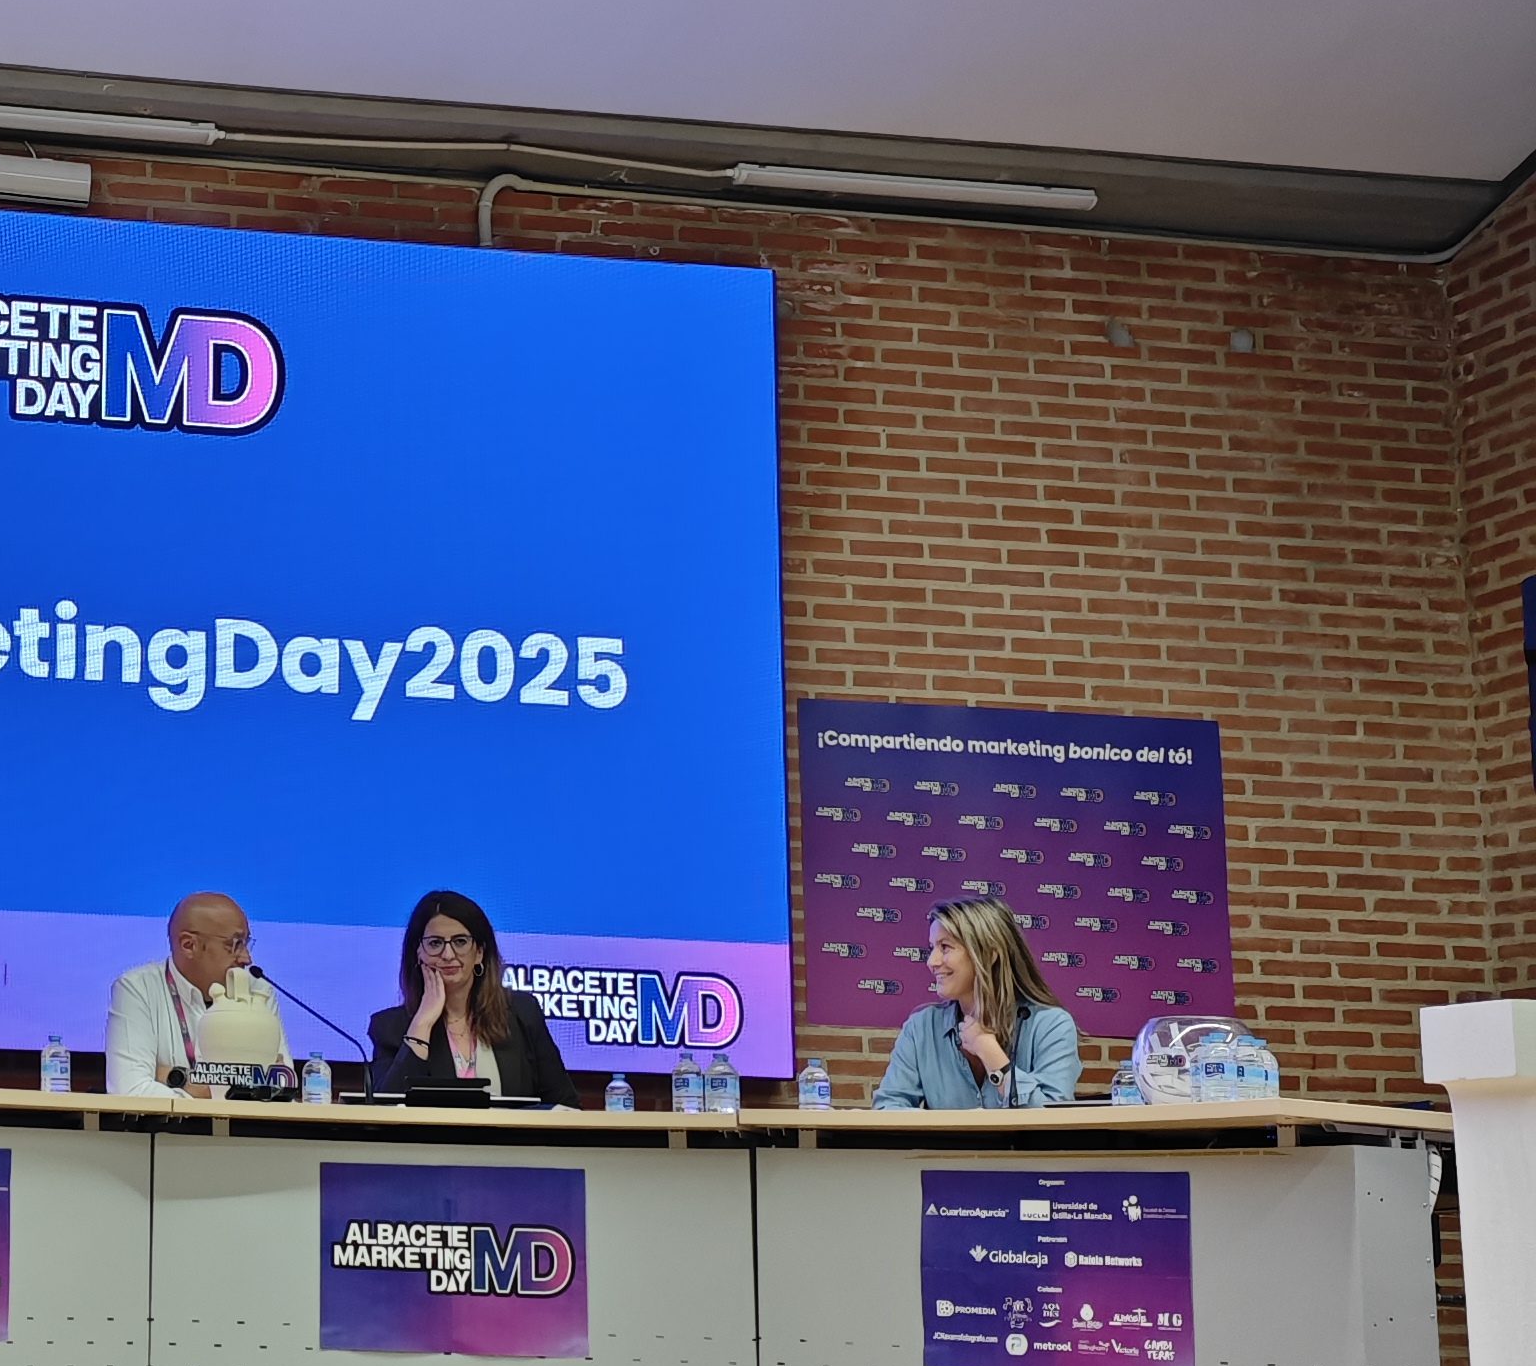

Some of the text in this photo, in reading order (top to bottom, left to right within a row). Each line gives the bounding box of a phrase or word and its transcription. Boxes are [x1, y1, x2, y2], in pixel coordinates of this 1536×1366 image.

[102, 306, 280, 431] MD
[14, 376, 100, 420] DAY
[817, 730, 1193, 766] ¡Compartiendo marketing bonico del tó!
[501, 966, 635, 995] ALBACETE
[531, 992, 638, 1020] KETING
[636, 973, 741, 1047] MD
[588, 1018, 637, 1044] DAY
[190, 1073, 254, 1085] MARKETING
[333, 1244, 471, 1270] MARKETING
[470, 1226, 573, 1295] MD
[988, 1250, 1049, 1268] Globalcaja
[430, 1269, 471, 1292] DAY
[954, 1305, 997, 1316] PROMEDIA
